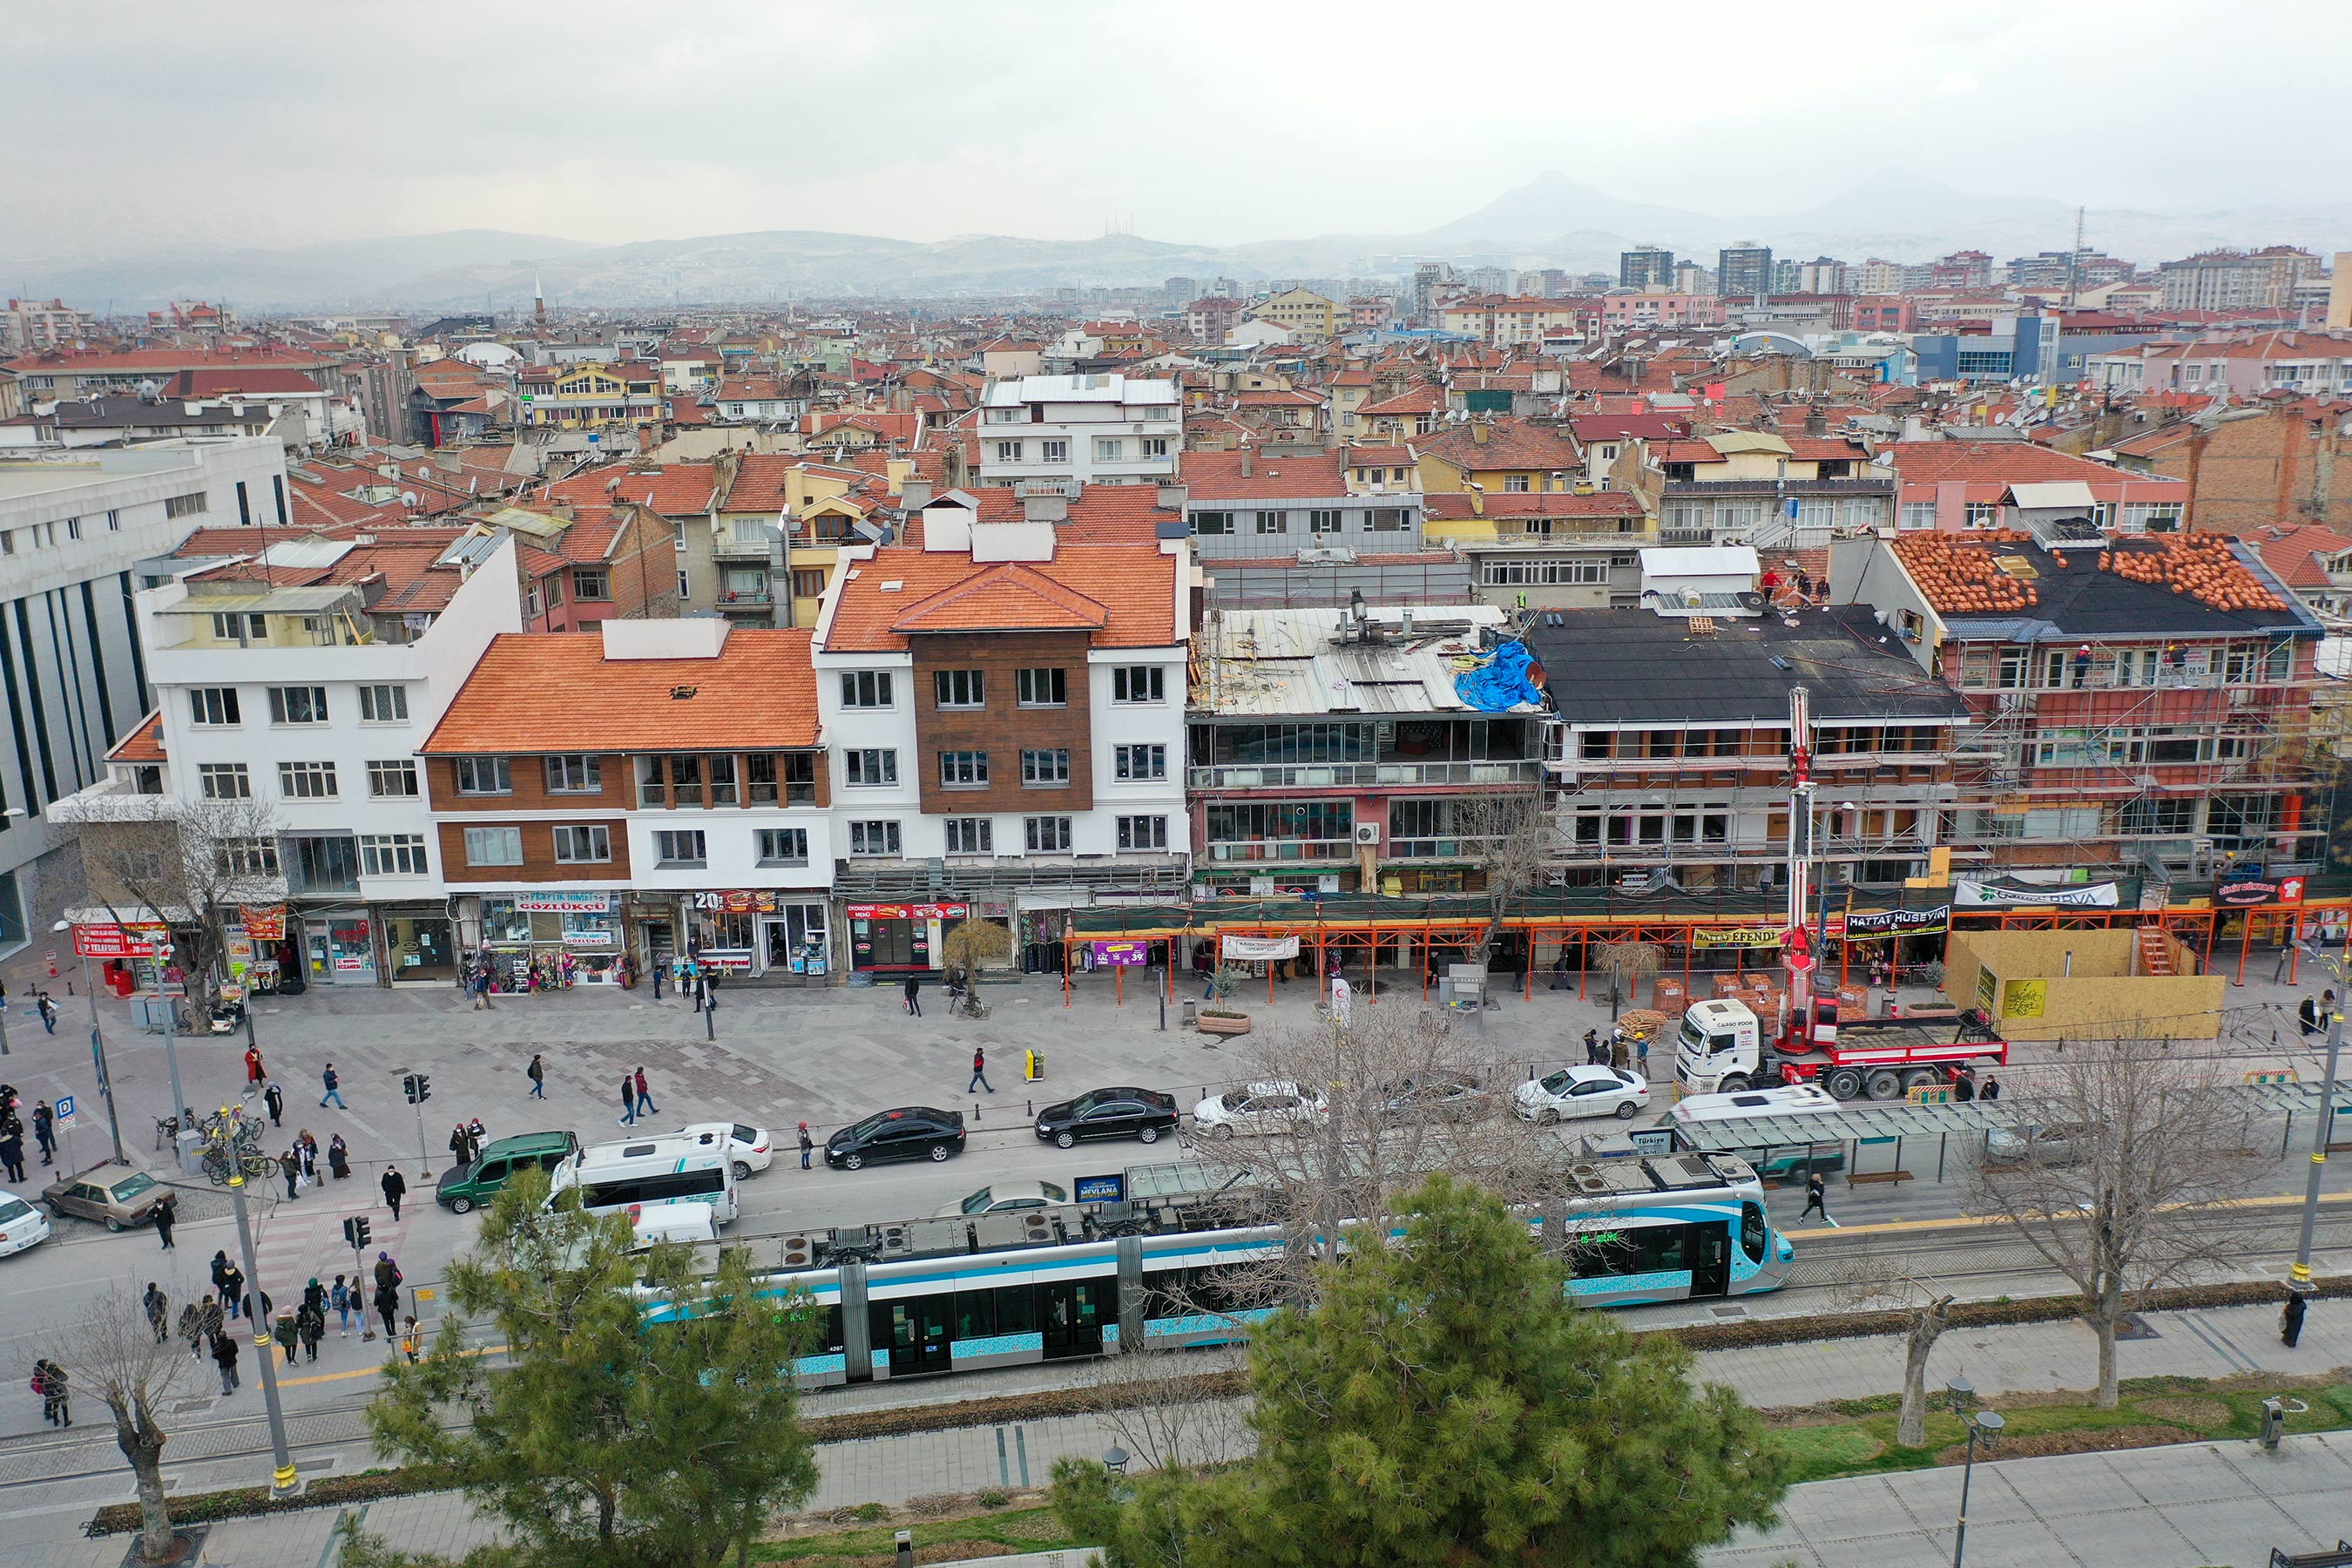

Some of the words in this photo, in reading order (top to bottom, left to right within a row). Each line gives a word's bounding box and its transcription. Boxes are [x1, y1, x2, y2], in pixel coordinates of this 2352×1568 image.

[520, 902, 605, 911] GÖZLÜKÇÜ
[1849, 916, 1892, 927] HATTAT
[1733, 930, 1775, 942] EFENDİ
[61, 1102, 69, 1113] D
[1638, 1136, 1665, 1145] Türkiye
[1080, 1186, 1118, 1196] MEVLANA
